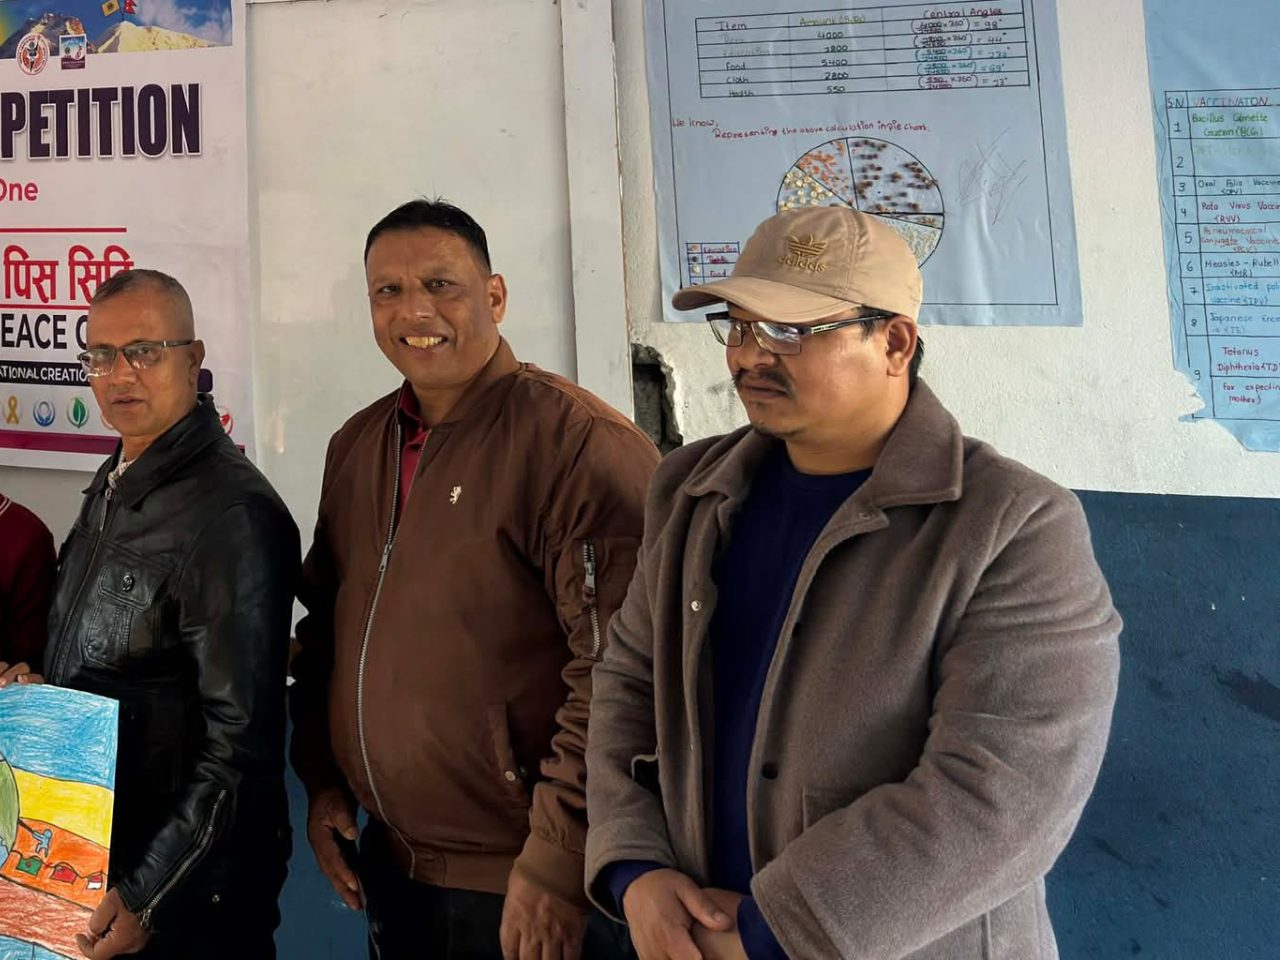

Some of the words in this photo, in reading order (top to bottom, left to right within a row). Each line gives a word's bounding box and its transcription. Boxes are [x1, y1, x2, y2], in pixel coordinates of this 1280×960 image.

[716, 21, 746, 31] Item
[817, 31, 843, 40] 4000
[1173, 121, 1182, 132] 1
[1176, 157, 1184, 168] 2
[1178, 182, 1186, 192] 3
[1181, 208, 1187, 217] 4
[1184, 231, 1193, 244] 5
[1186, 260, 1193, 272] 6
[3, 245, 59, 303] पिस
[1222, 346, 1259, 357] Tetanus
